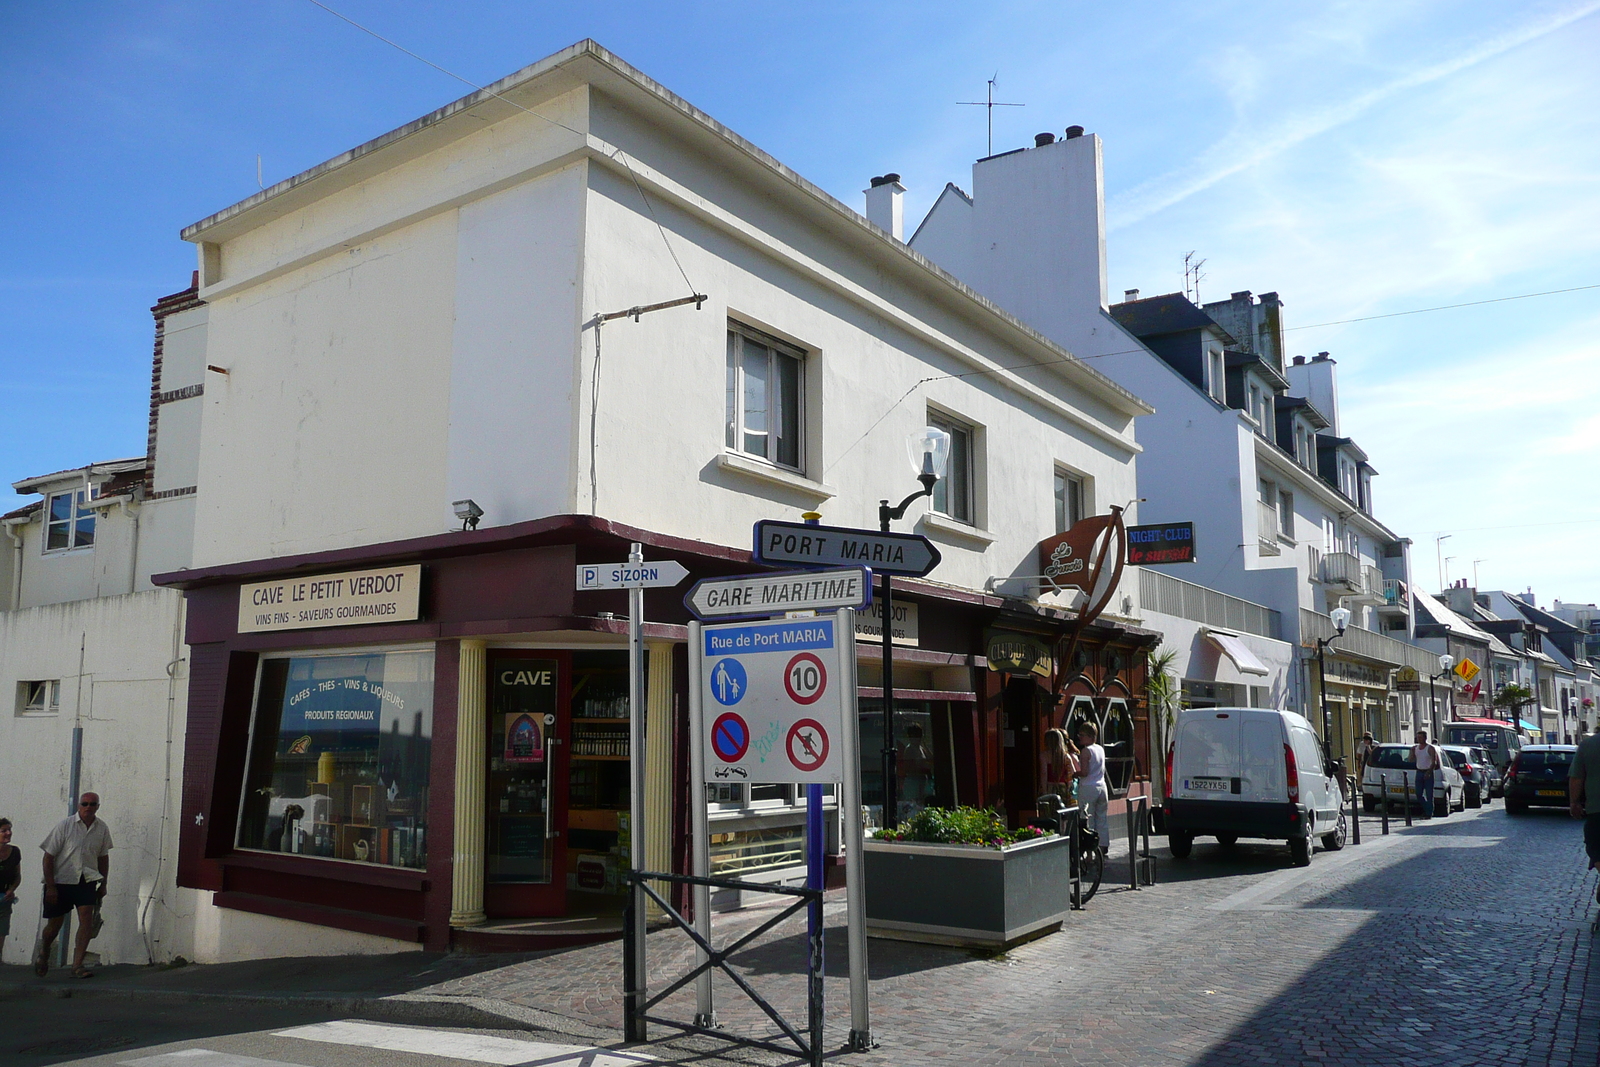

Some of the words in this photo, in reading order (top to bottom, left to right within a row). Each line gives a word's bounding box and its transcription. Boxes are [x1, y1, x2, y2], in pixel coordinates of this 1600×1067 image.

[1129, 527, 1191, 543] NIGHT-CLUB
[770, 533, 827, 556] PORT
[840, 540, 904, 564] MARIA
[1130, 547, 1144, 563] le
[585, 569, 595, 584] P
[612, 568, 658, 582] SIZORN
[253, 586, 283, 606] CAVE
[292, 584, 306, 602] LE
[310, 579, 344, 600] PETIT
[349, 573, 404, 596] VERDOT
[707, 586, 753, 608] GARE
[761, 578, 857, 604] MARITIME
[255, 613, 272, 625] VINS
[274, 612, 289, 624] FINS
[298, 607, 334, 622] SAVEURS
[336, 602, 397, 619] GOURMANDES
[711, 636, 733, 649] Rue
[736, 634, 751, 647] de
[754, 632, 779, 646] Port
[782, 628, 827, 644] MARIA
[991, 642, 1013, 661] CLUB
[1015, 642, 1026, 660] DE
[501, 670, 551, 686] CAVE
[792, 666, 818, 691] 10
[290, 688, 311, 706] CAFES
[318, 680, 335, 693] THES
[344, 679, 360, 690] VINS
[362, 682, 368, 692] &
[370, 684, 405, 710] LIQUEURS
[304, 710, 334, 720] PRODUITS
[335, 710, 374, 720] REGIONAUX
